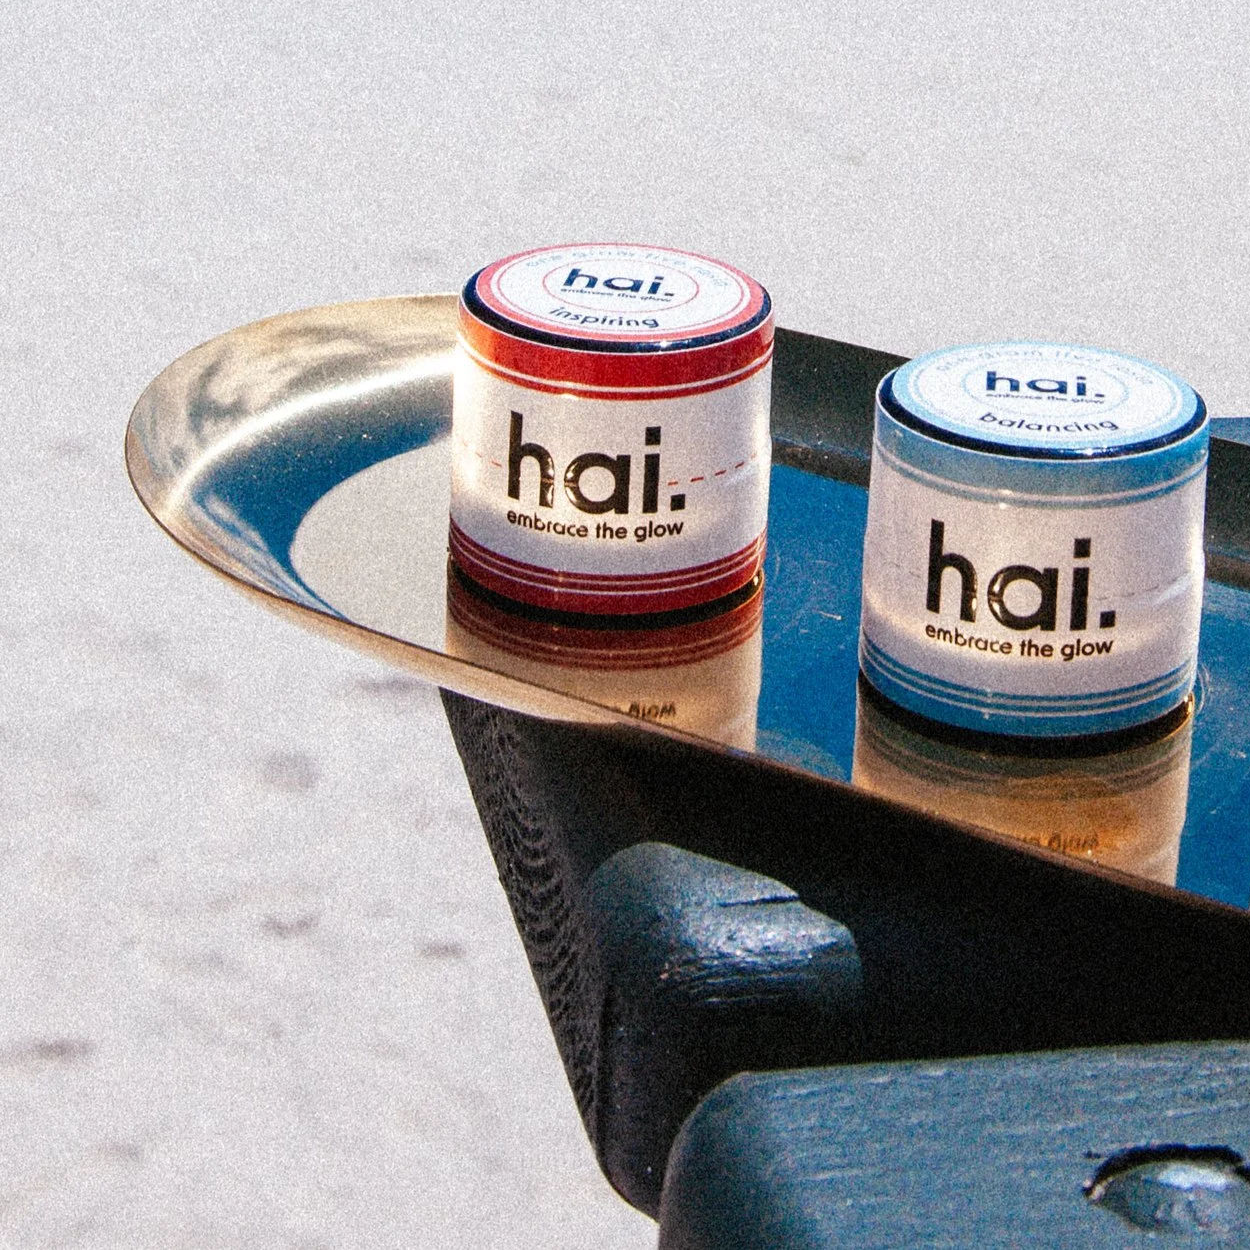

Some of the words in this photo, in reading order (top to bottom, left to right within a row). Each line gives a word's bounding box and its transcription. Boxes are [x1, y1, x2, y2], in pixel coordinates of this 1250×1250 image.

[563, 268, 675, 297] hai.
[548, 306, 659, 328] inspiring
[986, 371, 1105, 398] hai.
[979, 412, 1119, 432] balancing
[507, 410, 686, 515] hai.
[507, 508, 589, 538] embrace
[595, 521, 628, 540] the
[634, 520, 684, 543] glow
[926, 518, 1116, 632] hai.
[925, 624, 1013, 655] embrace
[1019, 638, 1054, 658] the
[1060, 638, 1114, 662] glow
